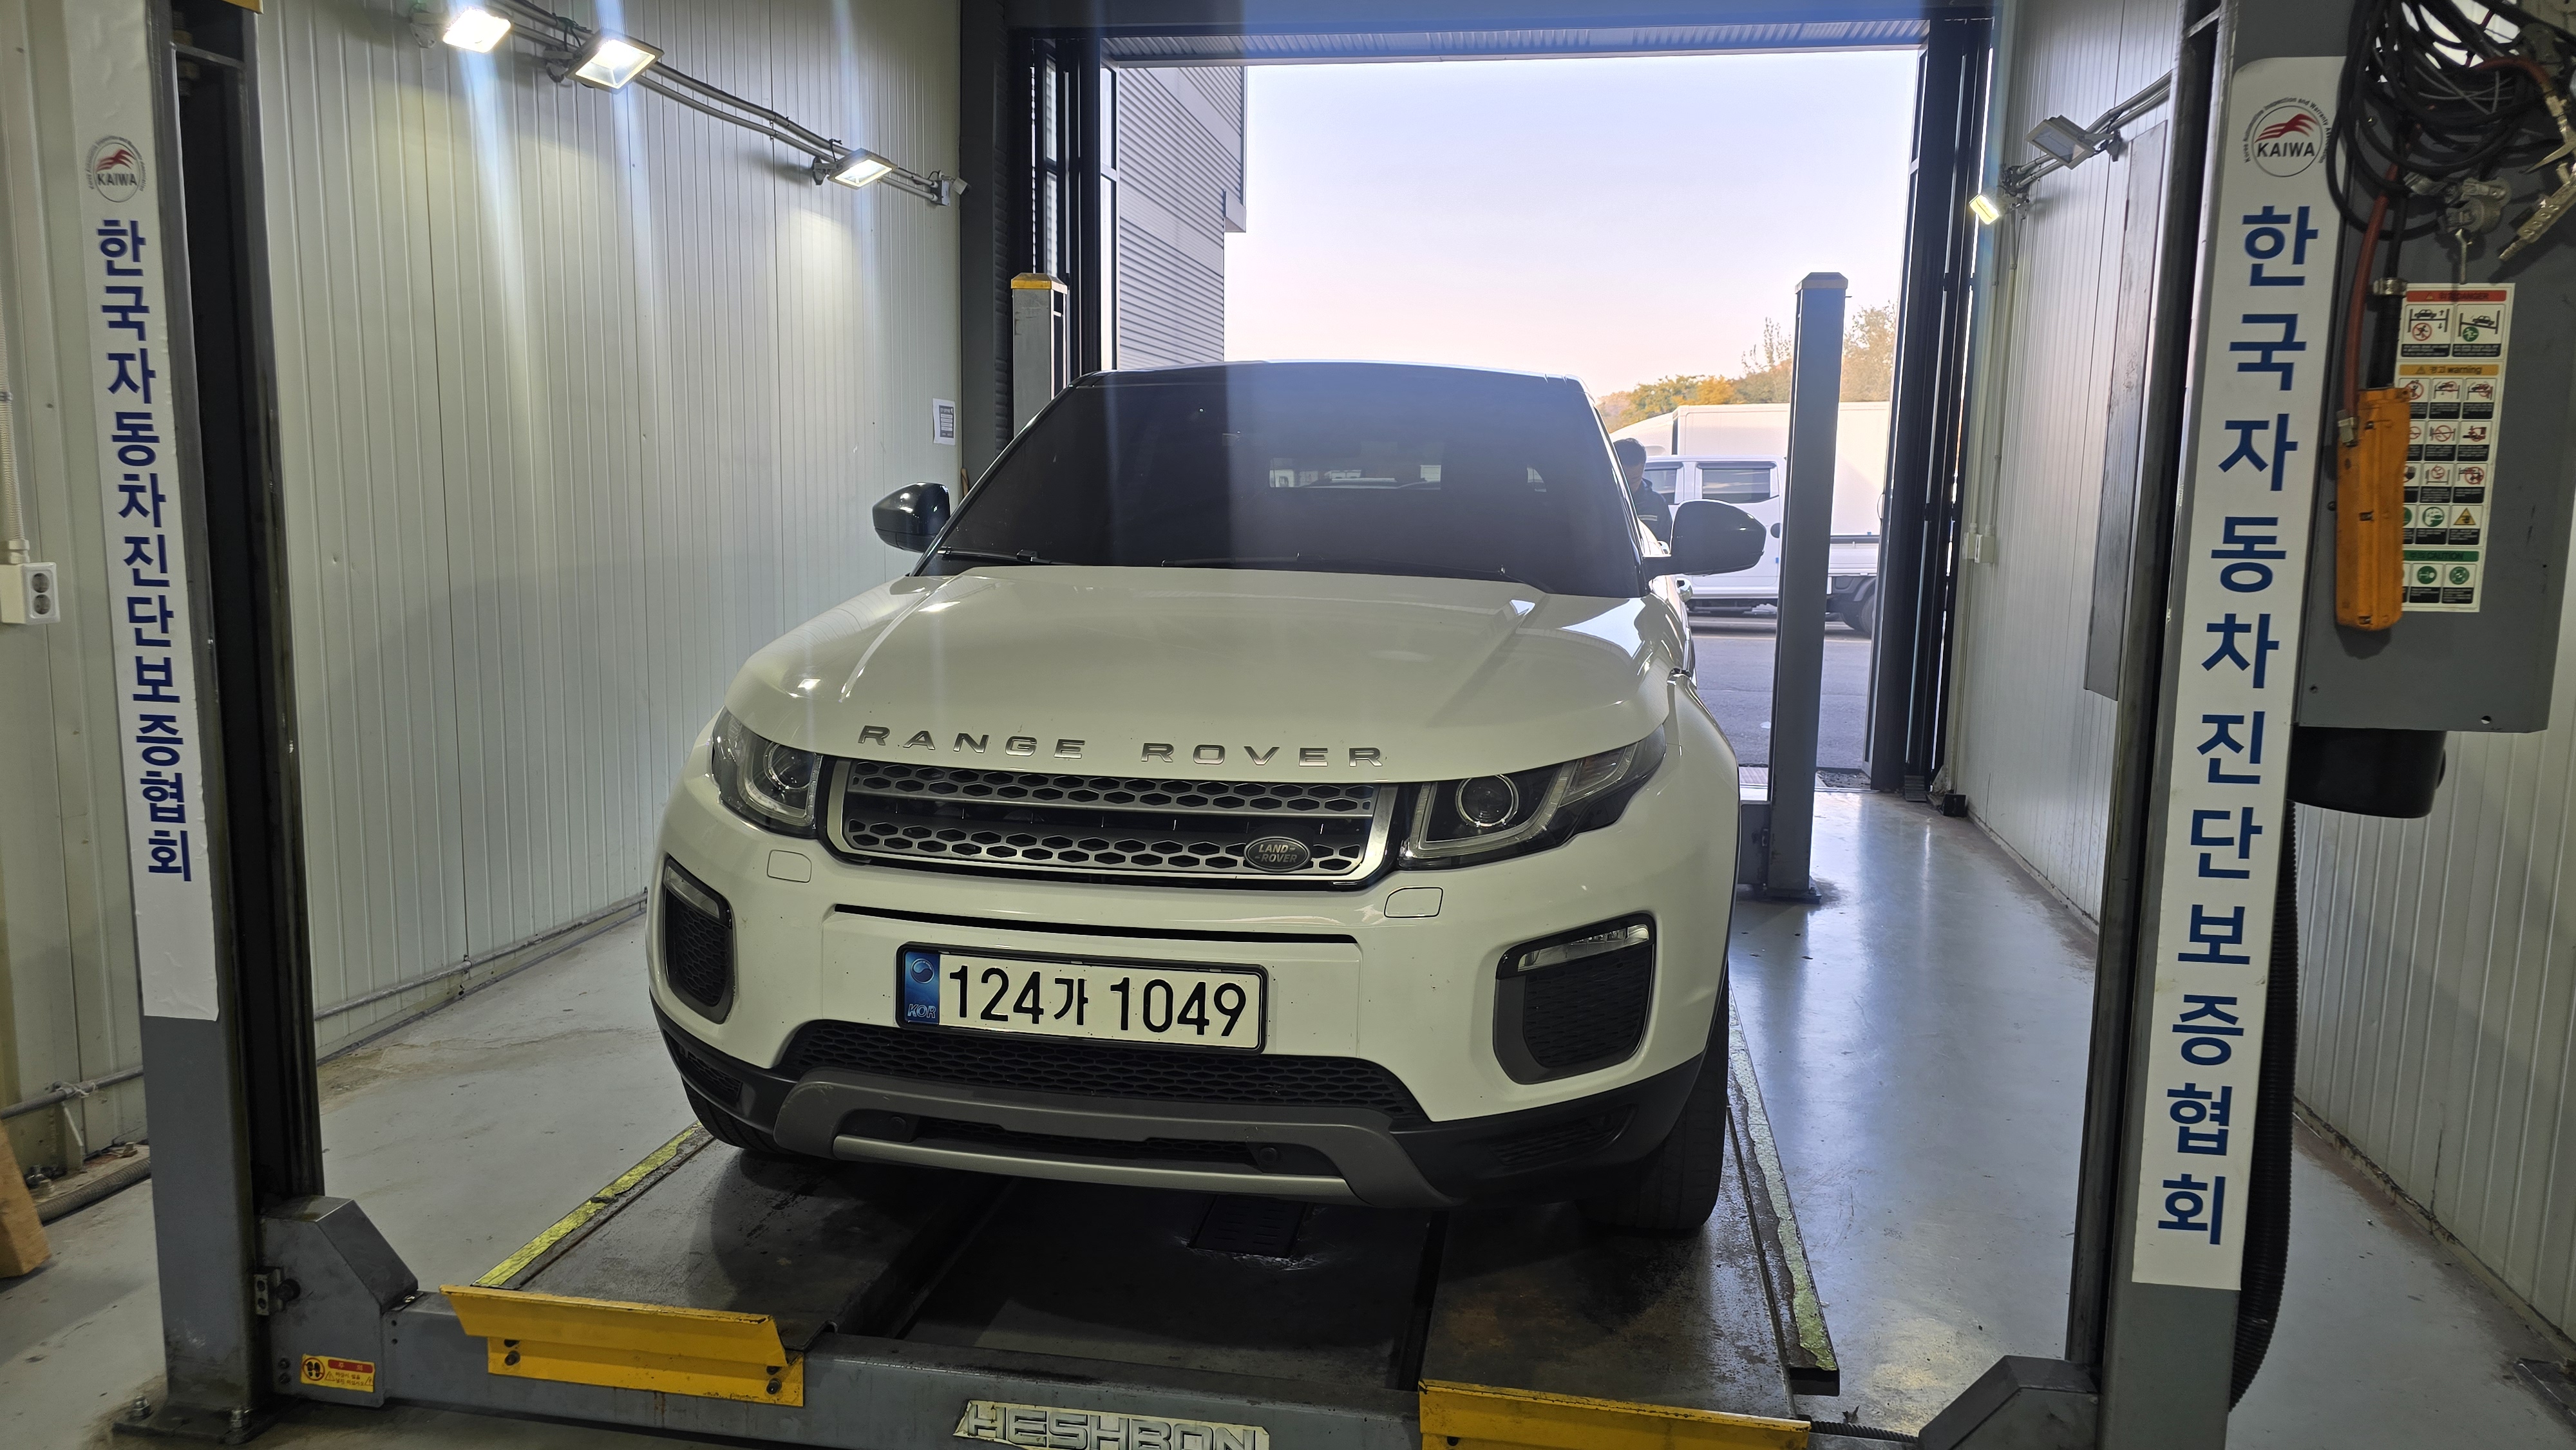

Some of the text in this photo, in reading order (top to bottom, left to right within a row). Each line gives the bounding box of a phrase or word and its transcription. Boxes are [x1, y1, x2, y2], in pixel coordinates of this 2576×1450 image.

[2257, 142, 2315, 158] KAIWA
[97, 173, 138, 187] KAIWA
[2448, 366, 2483, 375] warning
[97, 219, 190, 881] 한국자동차진단보증협회
[2159, 206, 2318, 1245] 한국자동차진단보증협회
[858, 725, 1383, 767] RANGE ROVER
[1258, 843, 1289, 854] LAND
[1260, 853, 1298, 863] ROVER
[949, 965, 1247, 1037] 124가 1049
[907, 1003, 936, 1019] KOR
[967, 1402, 1257, 1450] HESHBON
